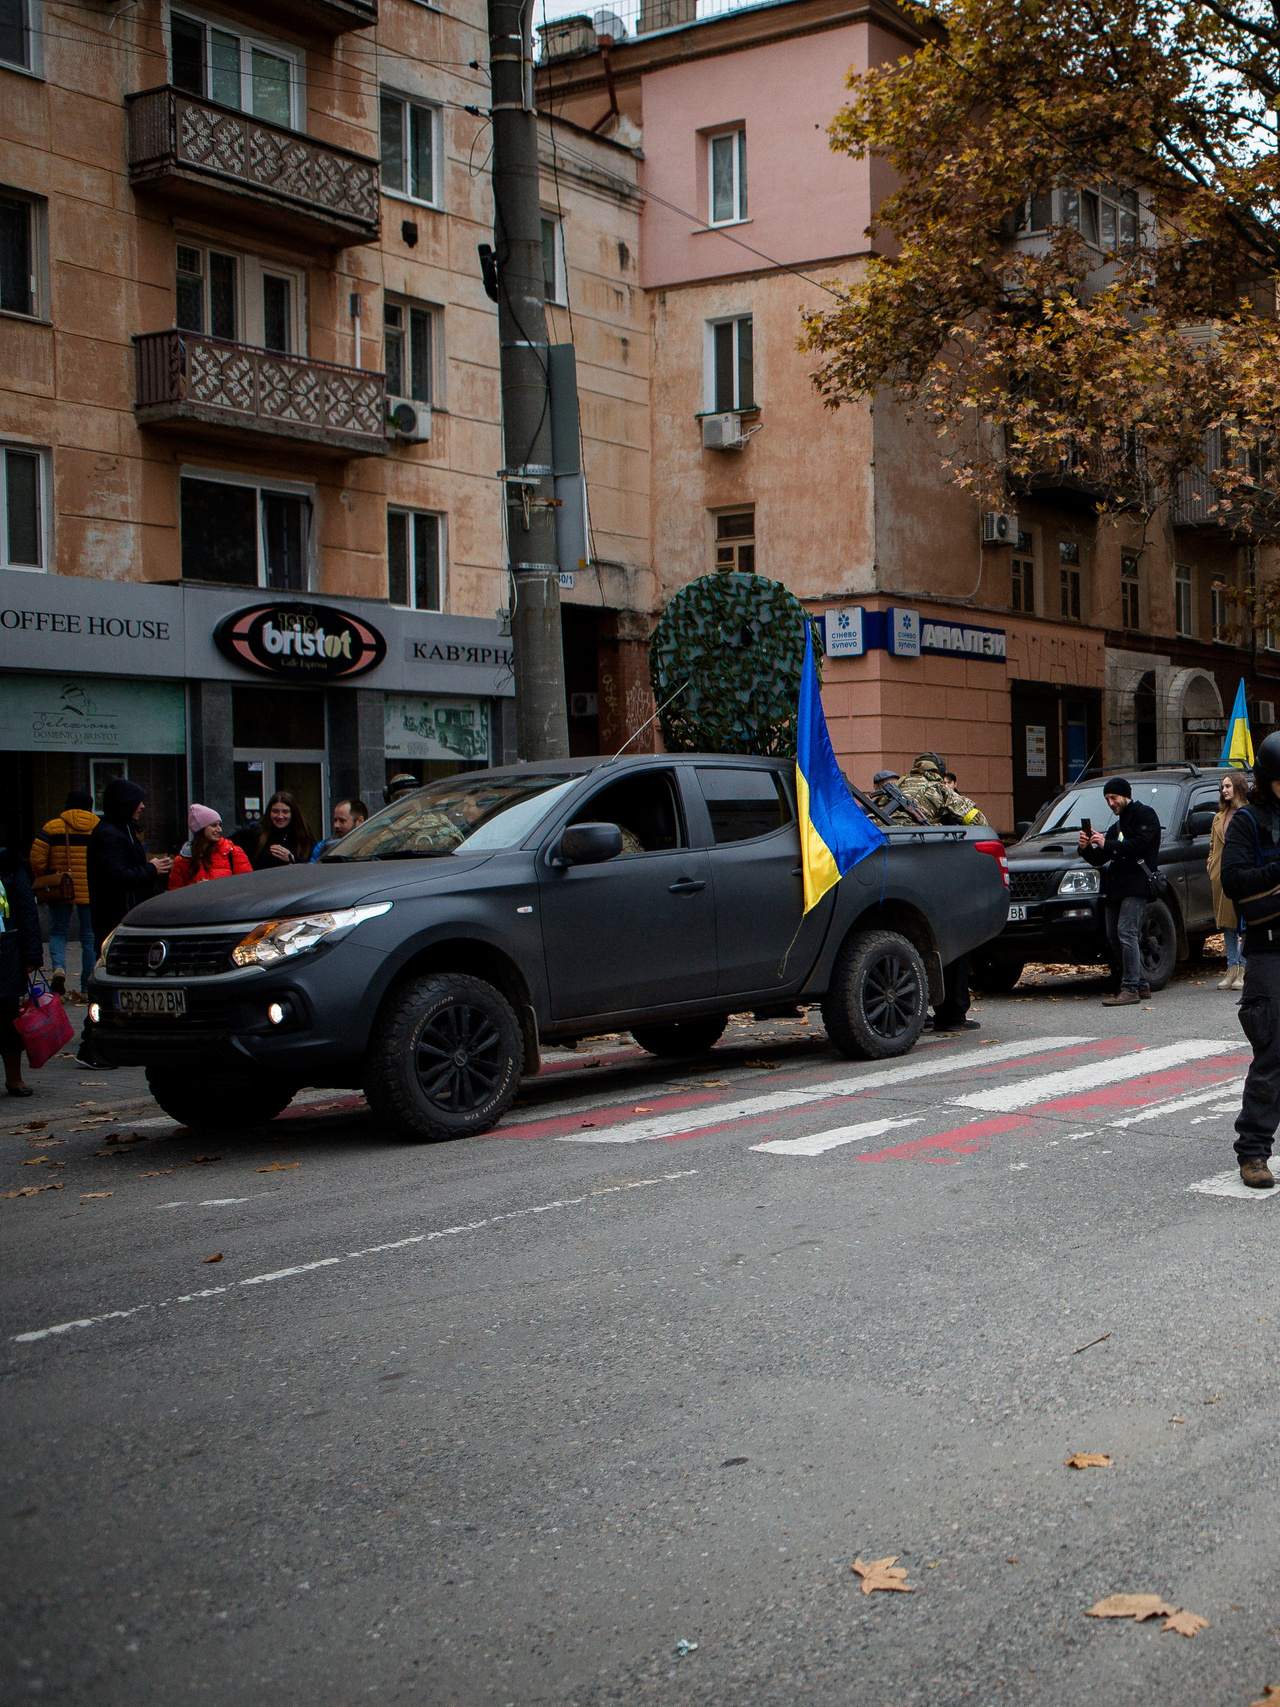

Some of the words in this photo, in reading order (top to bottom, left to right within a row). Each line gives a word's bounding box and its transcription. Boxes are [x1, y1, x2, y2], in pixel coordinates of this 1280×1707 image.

[87, 616, 171, 641] HOUSE
[278, 612, 319, 633] 1919
[261, 620, 353, 660] bristot
[831, 641, 858, 651] synevo
[897, 640, 917, 650] synevo
[921, 624, 1006, 656] АНАЛІЗИ
[84, 732, 119, 742] BRISTOT
[1010, 908, 1024, 919] BA
